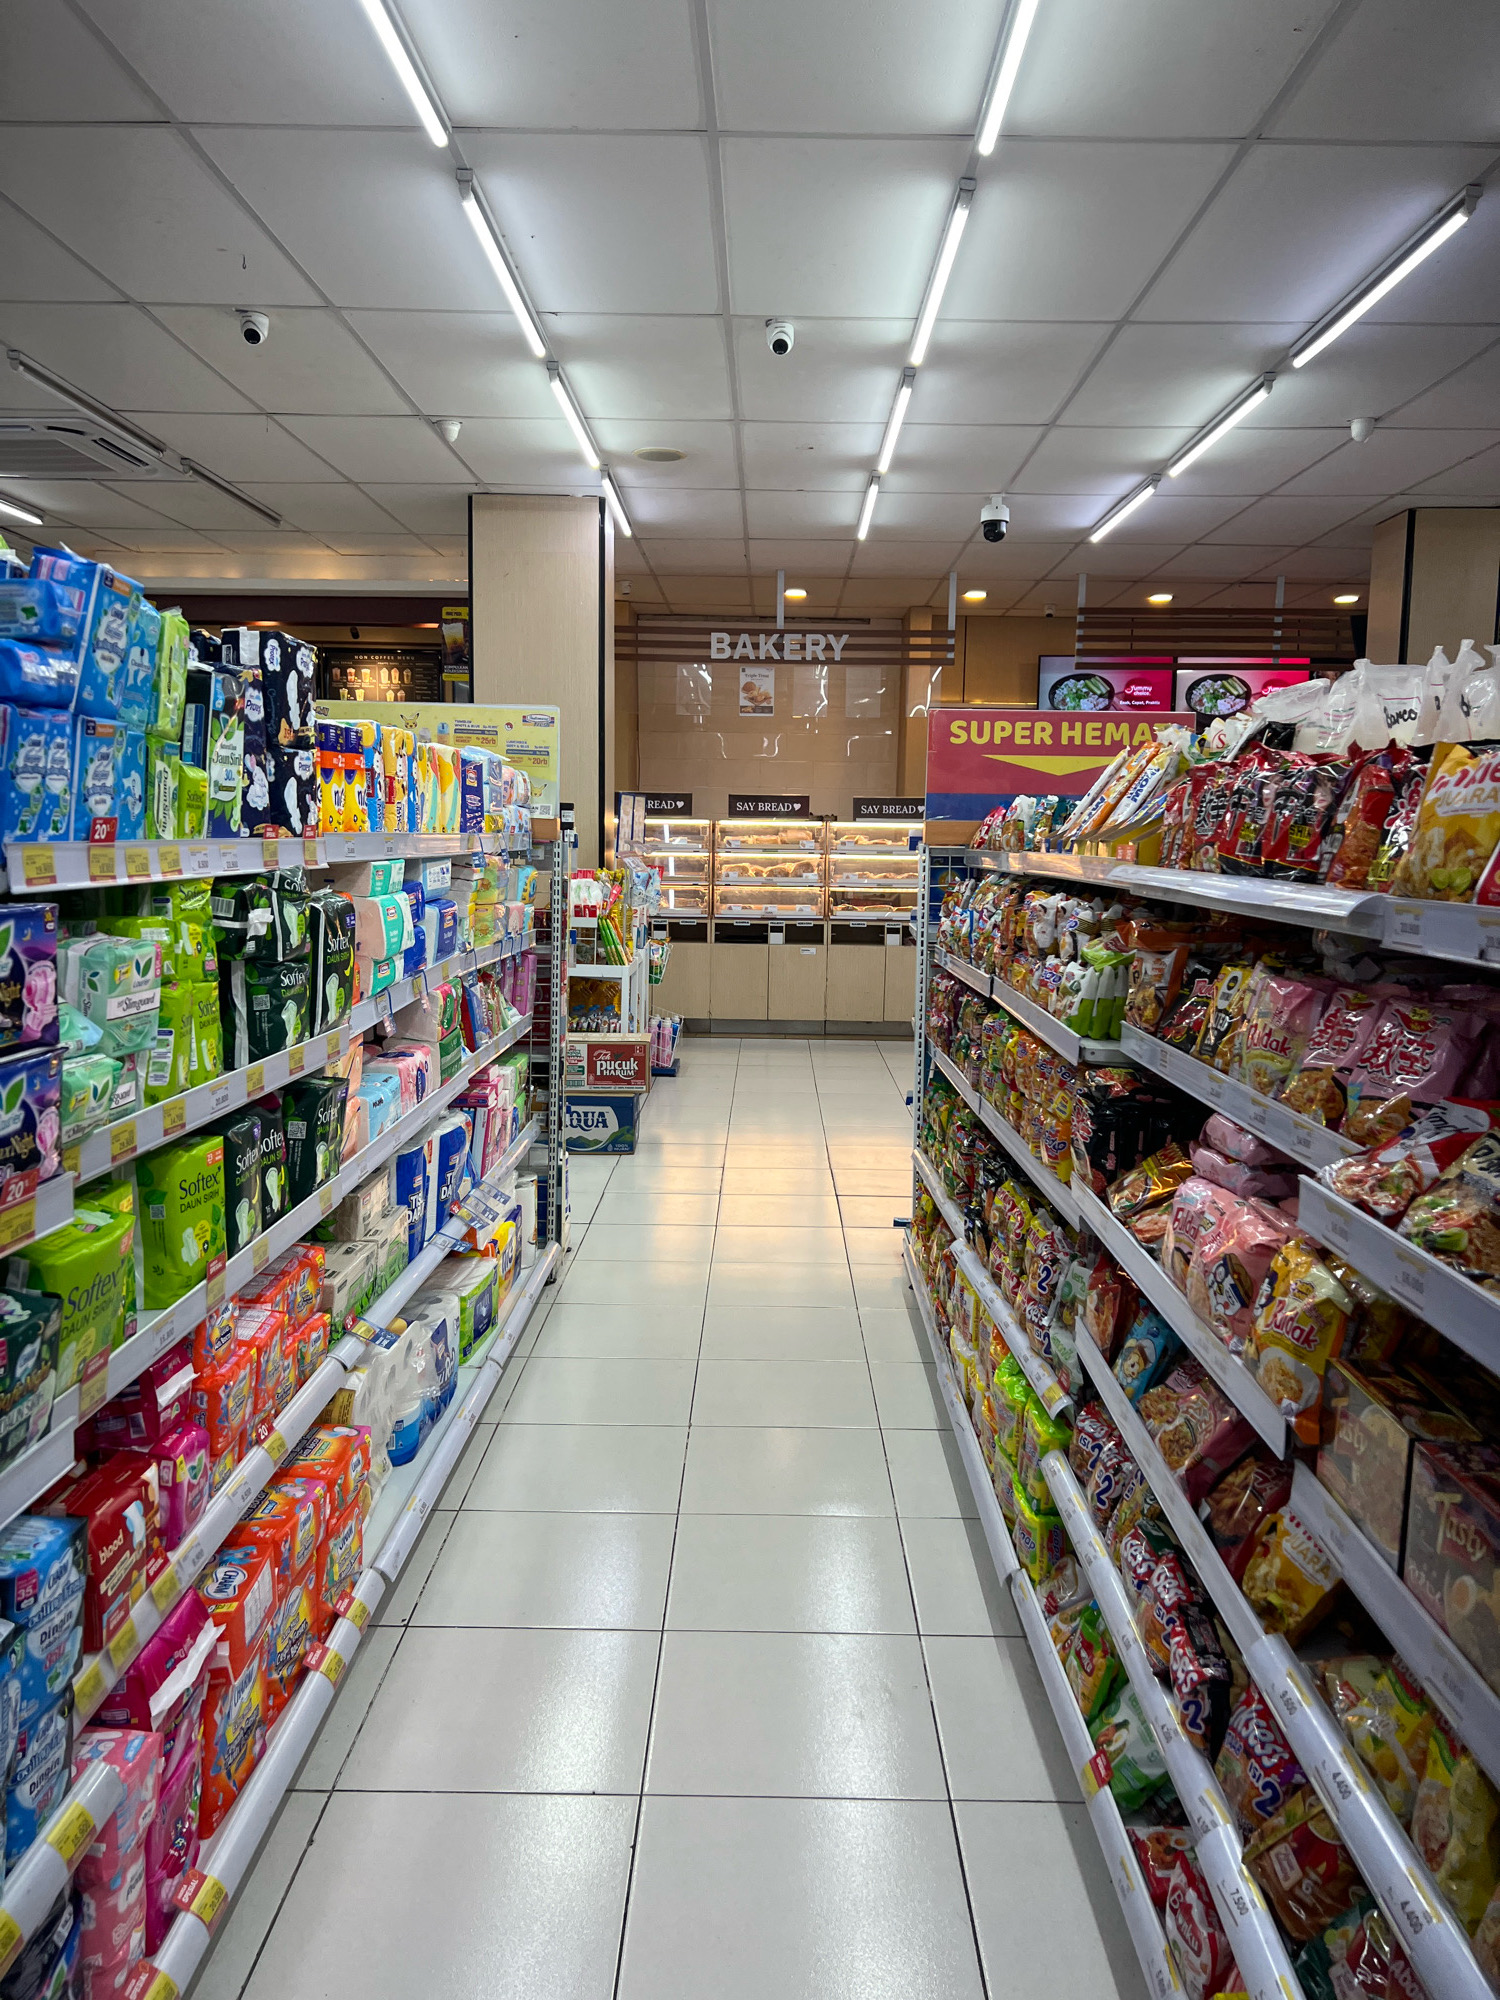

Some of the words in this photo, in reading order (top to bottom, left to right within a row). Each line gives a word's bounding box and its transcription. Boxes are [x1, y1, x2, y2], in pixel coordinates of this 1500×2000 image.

[710, 632, 849, 661] BAKERY
[1126, 684, 1152, 694] Yummy
[950, 720, 1053, 746] SUPER
[1061, 722, 1171, 746] HEMA
[532, 757, 547, 765] 20rb
[646, 800, 675, 810] READ
[736, 802, 756, 811] SAY
[758, 802, 792, 812] BREAD
[860, 805, 880, 814] SAY
[881, 805, 916, 815] BREAD
[1246, 1022, 1292, 1057] Buldak
[593, 1049, 611, 1060] Teh
[596, 1057, 639, 1076] pucuk
[603, 1069, 635, 1078] HARUM
[566, 1110, 609, 1132] QUA
[179, 1166, 222, 1200] Softex
[180, 1197, 202, 1214] DAUN
[203, 1189, 220, 1205] SIRIH
[64, 1258, 125, 1321] Softex
[1262, 1297, 1319, 1351] Buldak
[1079, 1434, 1091, 1449] ISI
[1096, 1474, 1113, 1507] 2
[1124, 1482, 1136, 1500] ISI
[99, 1528, 124, 1565] blood
[212, 1569, 240, 1595] CHARM
[40, 1610, 73, 1645] Dingin
[1181, 1699, 1204, 1734] 2
[1249, 1761, 1262, 1784] ISI
[1255, 1780, 1281, 1818] 2
